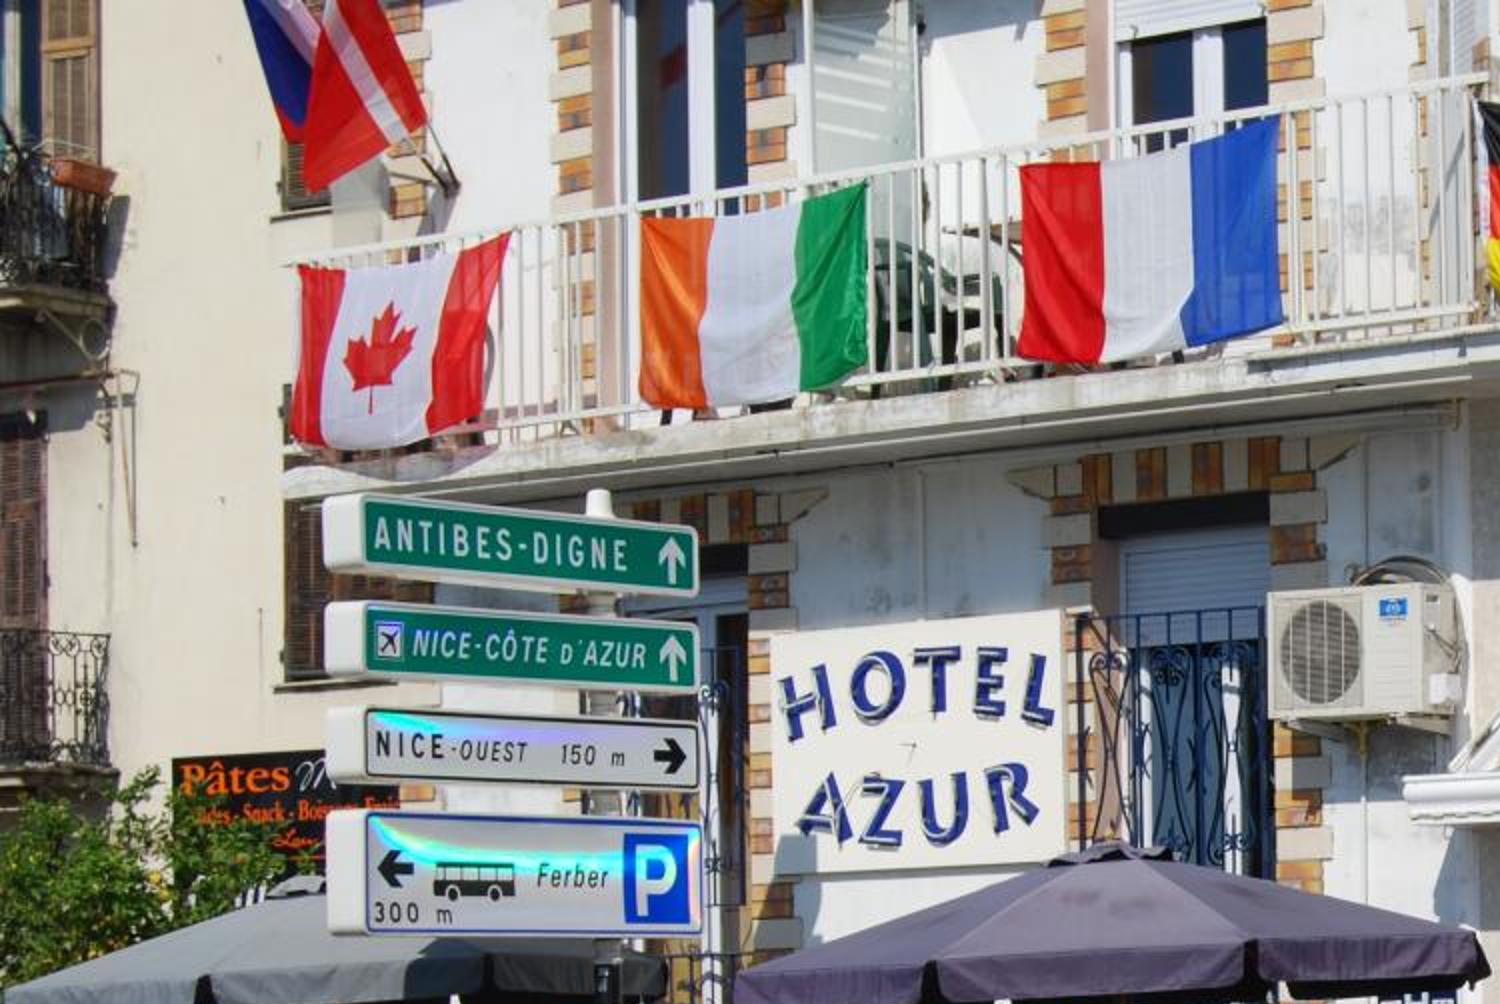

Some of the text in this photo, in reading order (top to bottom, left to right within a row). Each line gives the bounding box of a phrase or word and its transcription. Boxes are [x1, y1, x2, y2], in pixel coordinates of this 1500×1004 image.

[373, 516, 629, 573] ANTIBES-DIGNE
[412, 627, 548, 664] NICE-CÔTE
[776, 644, 1056, 744] HOTEL
[375, 729, 626, 768] NICE-OUEST 150 m
[178, 758, 292, 798] Pâtes
[794, 761, 1041, 851] AZUR
[536, 843, 678, 918] Ferber P
[373, 900, 454, 925] 300 m
